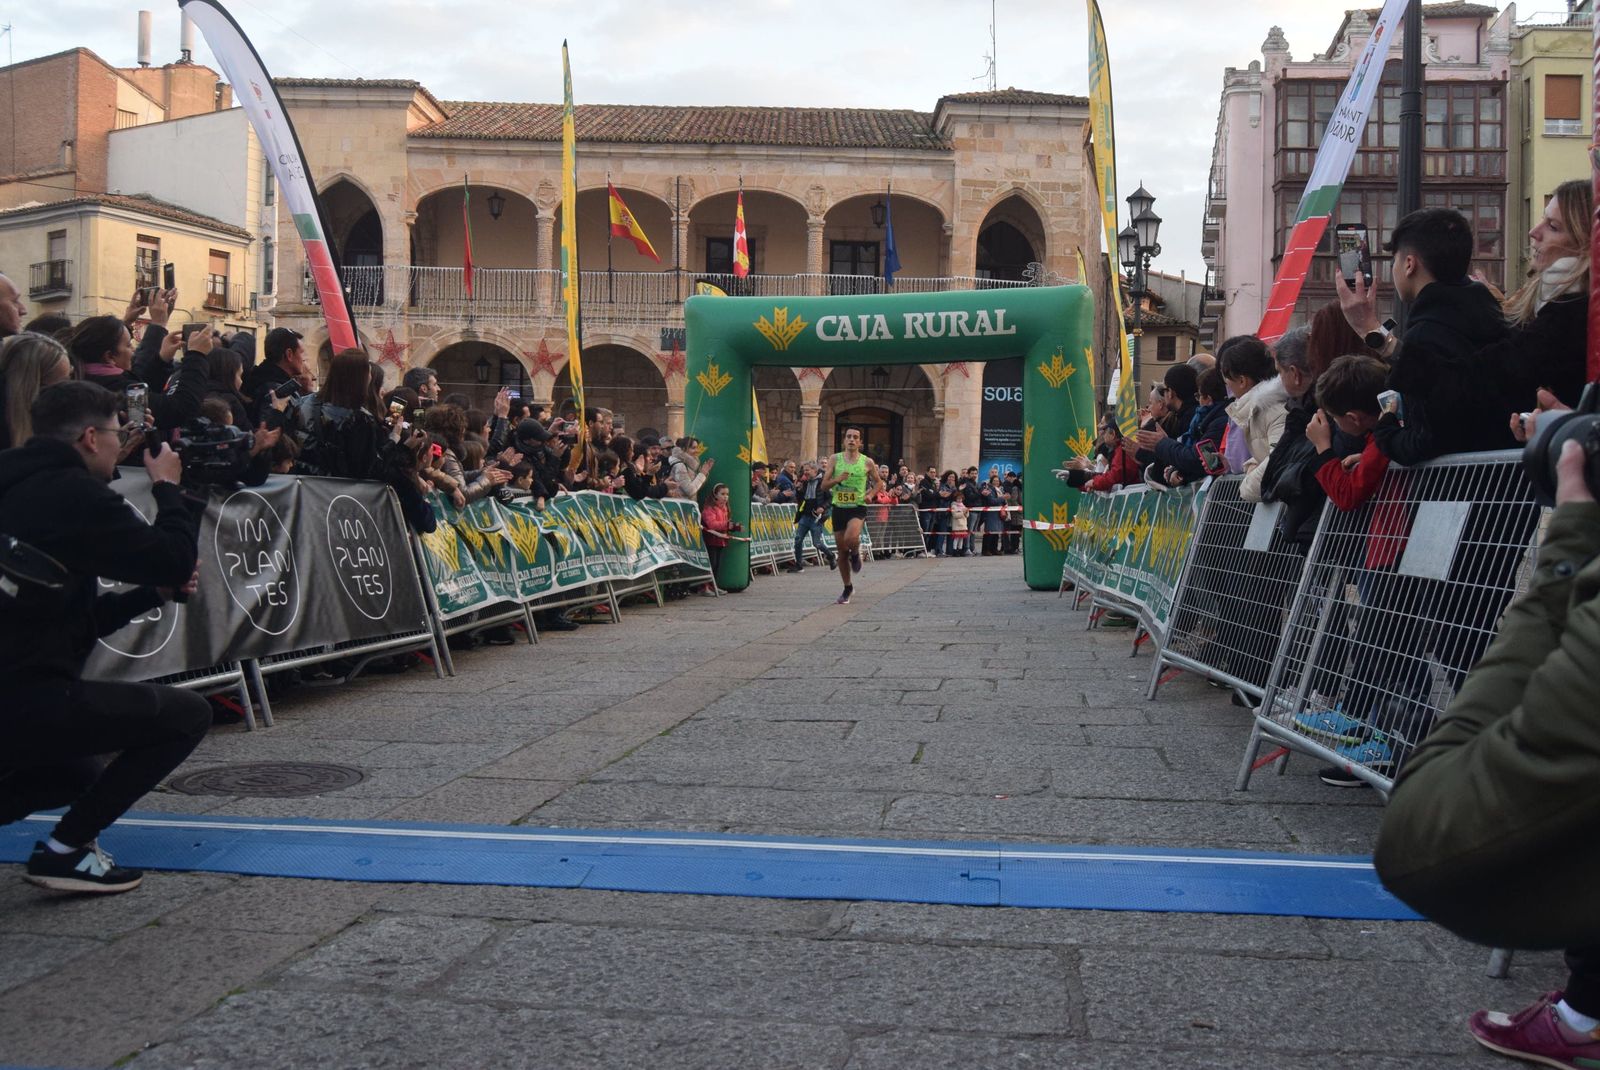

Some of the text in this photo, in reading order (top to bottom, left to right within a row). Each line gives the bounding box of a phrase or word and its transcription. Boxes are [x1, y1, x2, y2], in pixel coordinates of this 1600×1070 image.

[815, 308, 1016, 342] CAJA RURAL
[837, 492, 855, 502] 854
[236, 518, 271, 542] IM
[338, 519, 367, 540] IM
[246, 581, 288, 607] TES
[352, 574, 384, 595] TES
